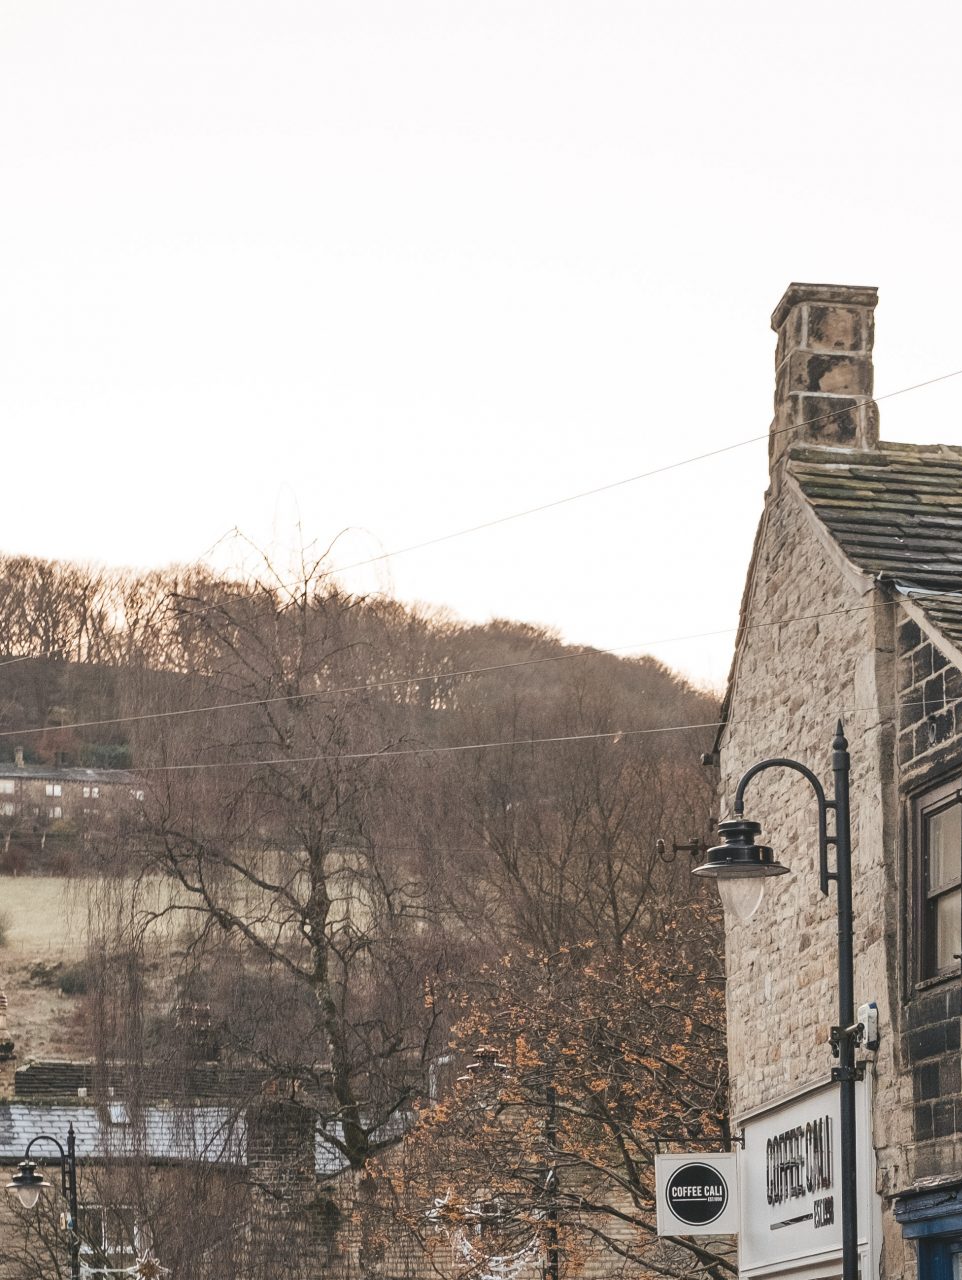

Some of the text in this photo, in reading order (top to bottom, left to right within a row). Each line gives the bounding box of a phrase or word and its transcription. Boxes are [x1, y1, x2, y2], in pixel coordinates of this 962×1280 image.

[767, 1115, 833, 1207] COFFEE CALI
[671, 1185, 723, 1198] COFFEE CALI
